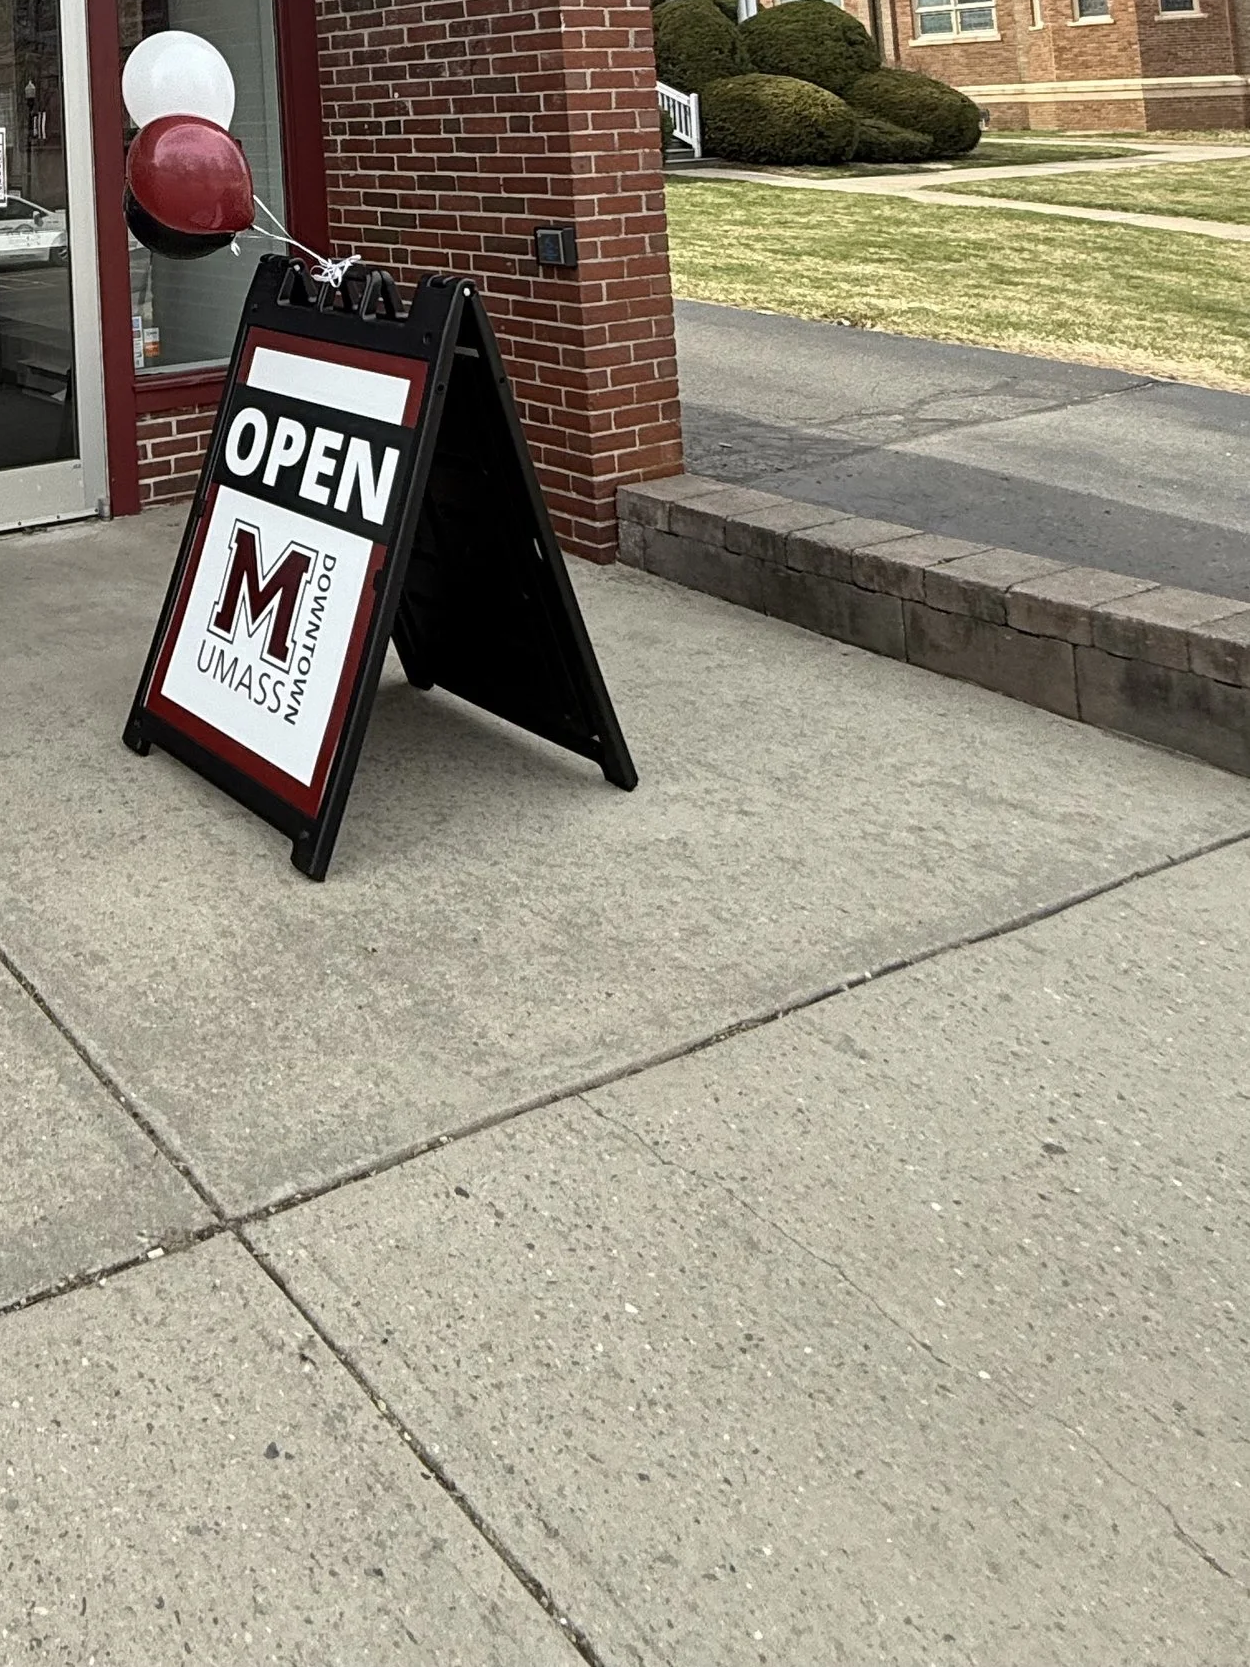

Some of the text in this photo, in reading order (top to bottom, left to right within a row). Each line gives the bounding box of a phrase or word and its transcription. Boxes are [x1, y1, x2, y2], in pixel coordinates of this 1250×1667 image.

[224, 406, 401, 526] OPEN
[207, 518, 319, 675] M
[283, 553, 337, 726] DOWNTOWN
[196, 639, 286, 714] UMASS
